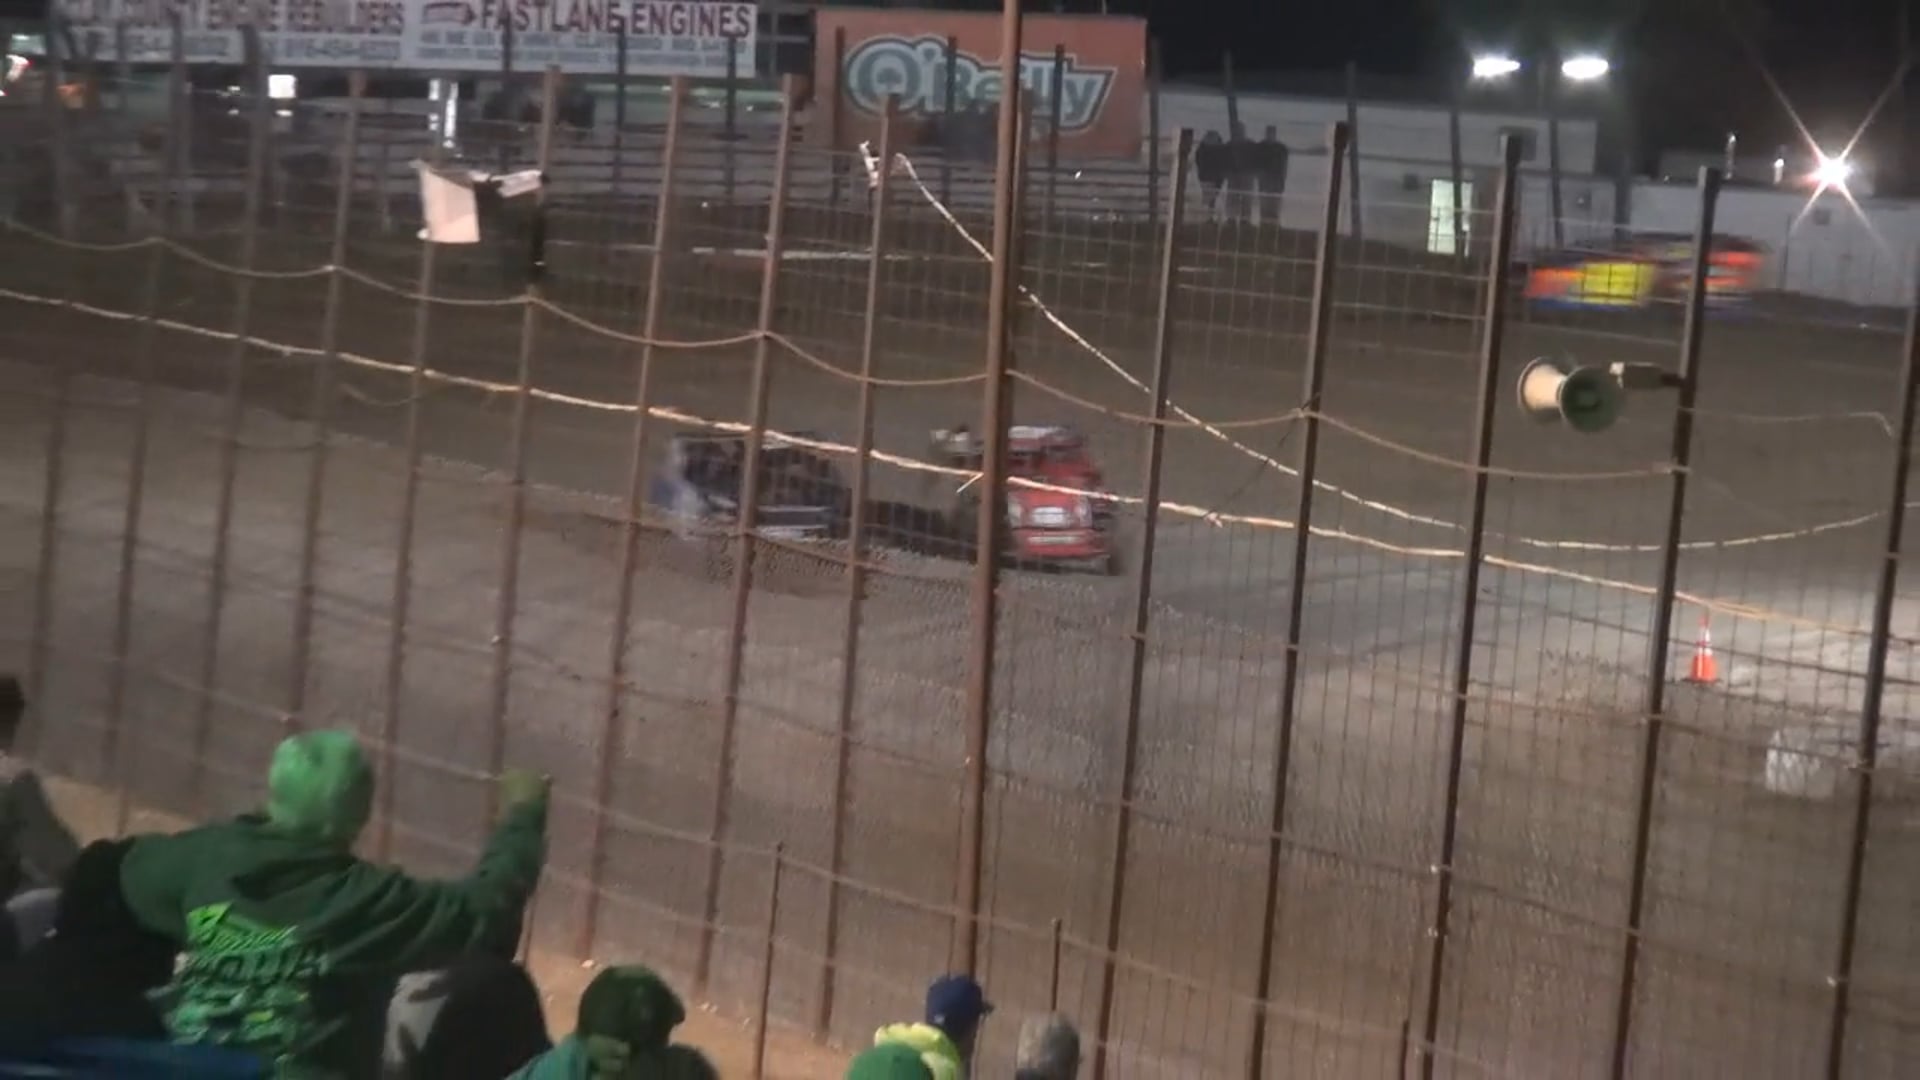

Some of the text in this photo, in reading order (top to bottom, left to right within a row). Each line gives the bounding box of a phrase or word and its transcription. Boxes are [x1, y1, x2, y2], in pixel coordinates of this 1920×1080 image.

[480, 0, 752, 38] FASTLANE ENGINES
[854, 43, 1102, 121] O'Relly
